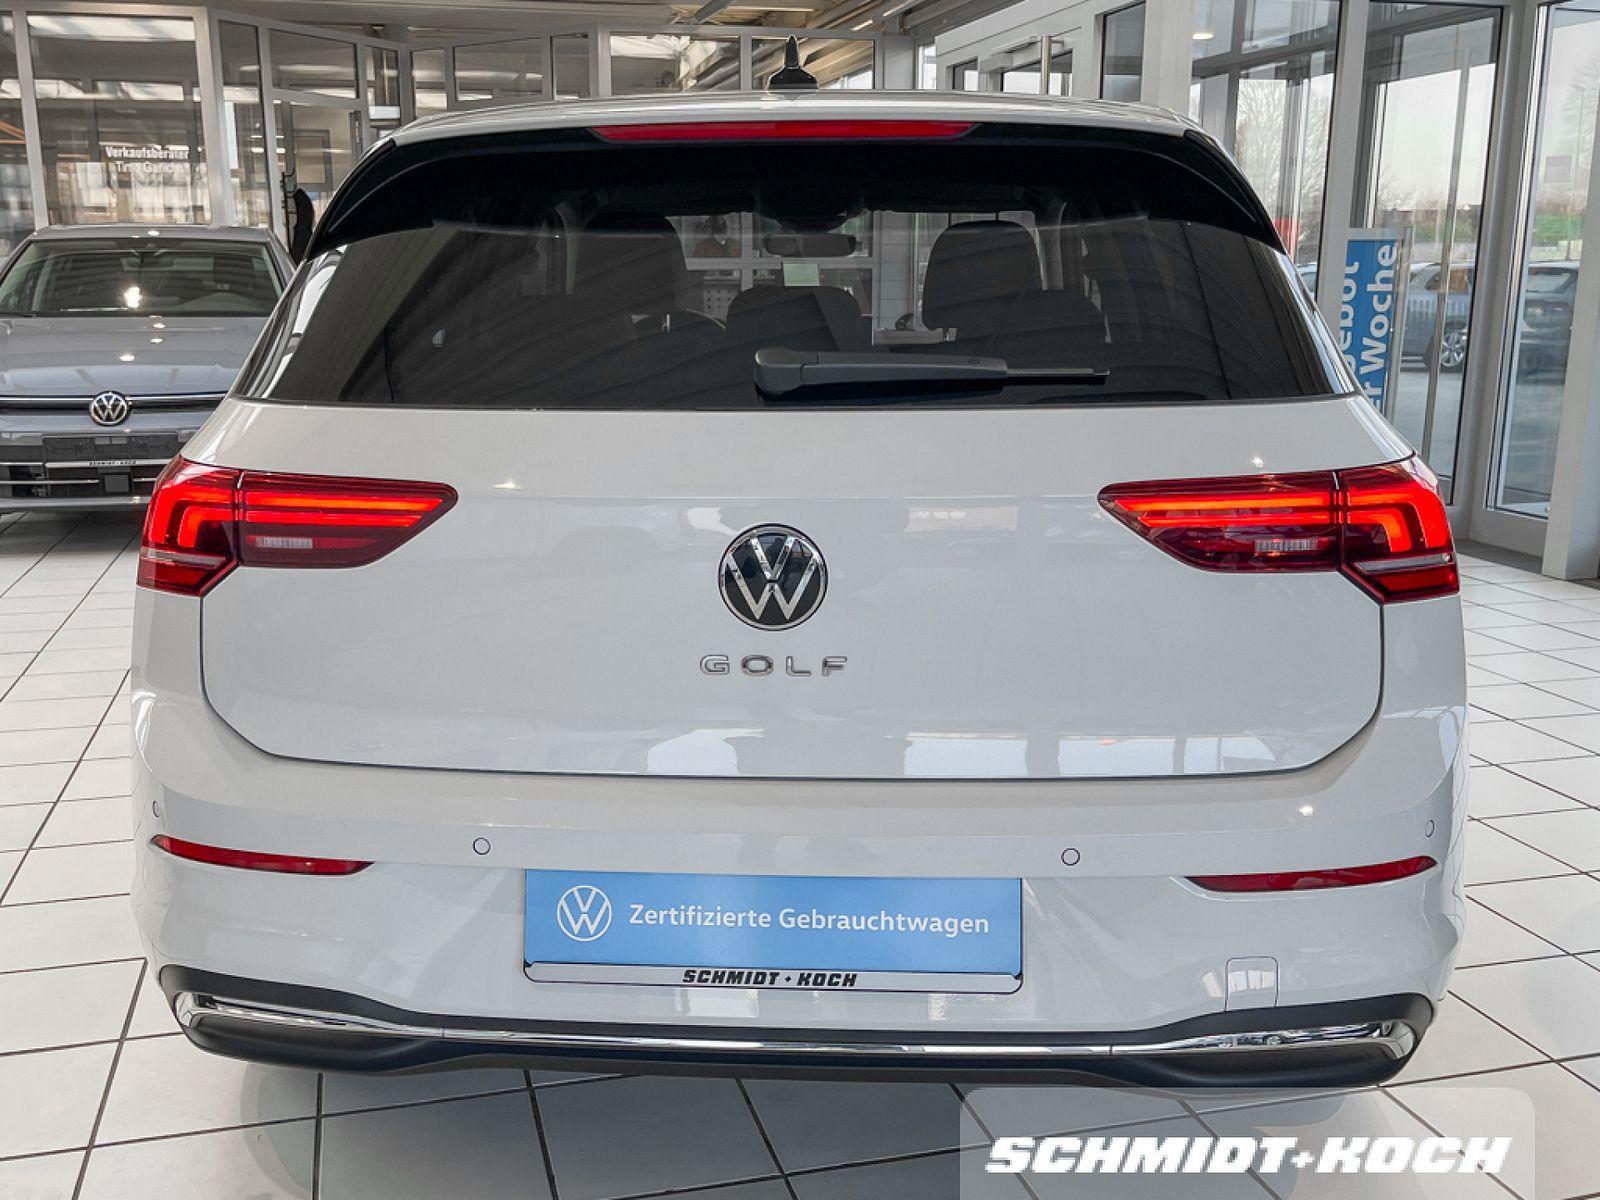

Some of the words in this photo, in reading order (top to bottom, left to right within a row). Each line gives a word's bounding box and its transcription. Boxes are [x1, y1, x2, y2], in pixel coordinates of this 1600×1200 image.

[1359, 244, 1399, 375] Woche
[700, 654, 848, 677] GOLF
[629, 903, 771, 928] Zertifizierte
[779, 908, 990, 938] Gebrauchtwagen
[682, 969, 780, 985] SCHMIDT
[796, 972, 858, 987] KOCH
